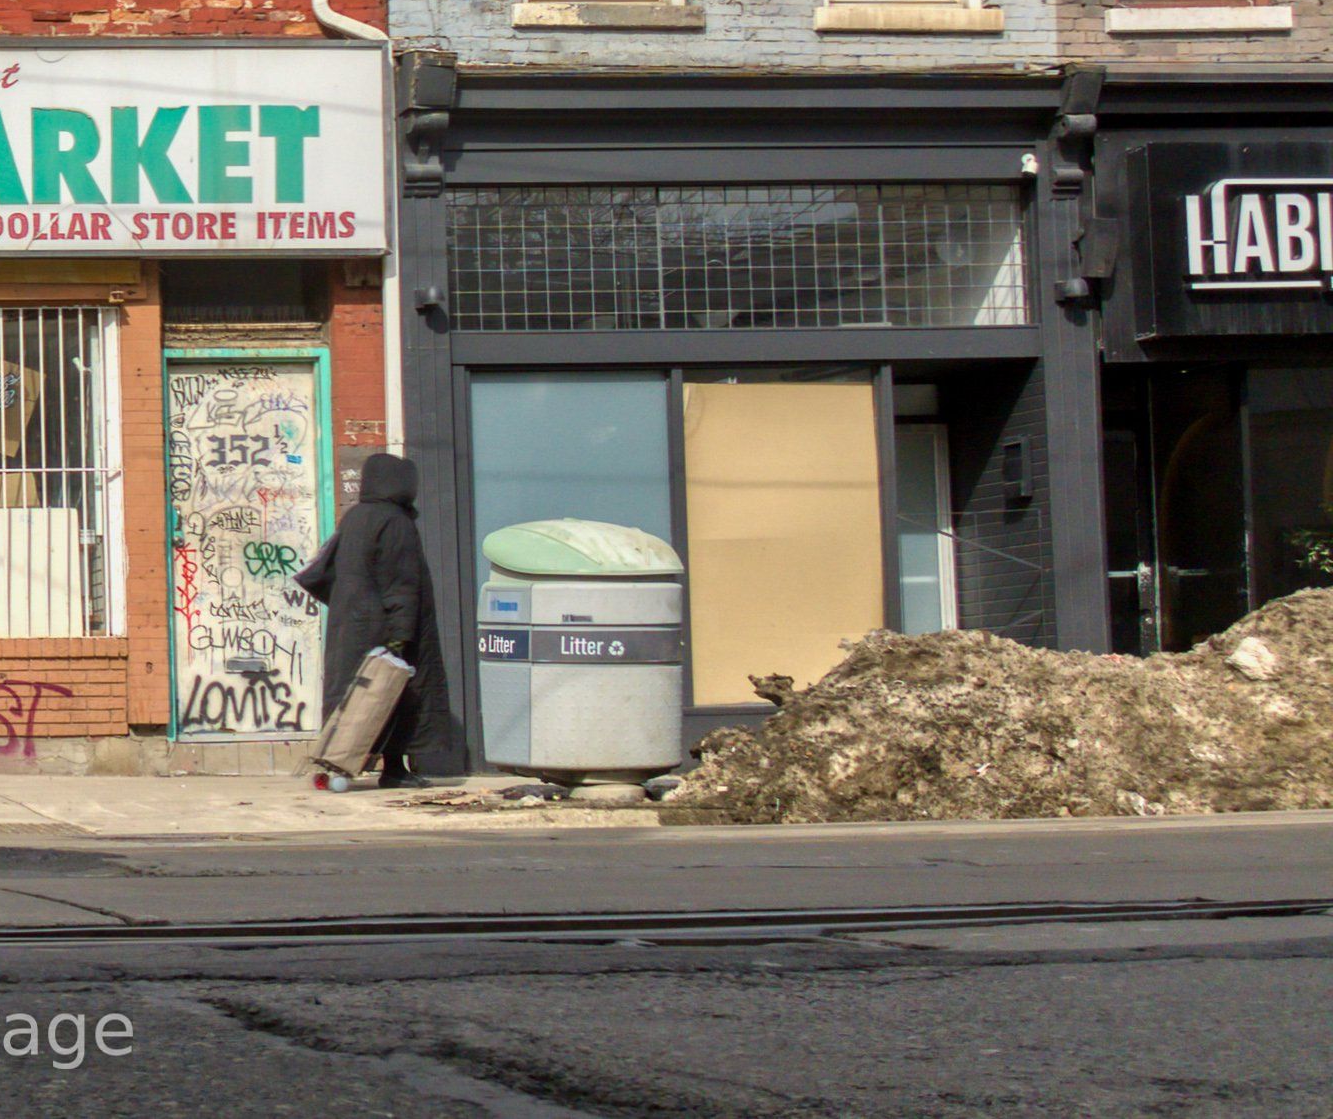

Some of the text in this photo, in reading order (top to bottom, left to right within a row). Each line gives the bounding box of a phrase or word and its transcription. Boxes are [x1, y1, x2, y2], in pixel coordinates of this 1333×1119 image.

[133, 212, 237, 241] STORE
[257, 211, 357, 240] ITEMS
[206, 434, 272, 467] 352
[488, 634, 516, 653] Litter
[561, 635, 604, 656] Litter
